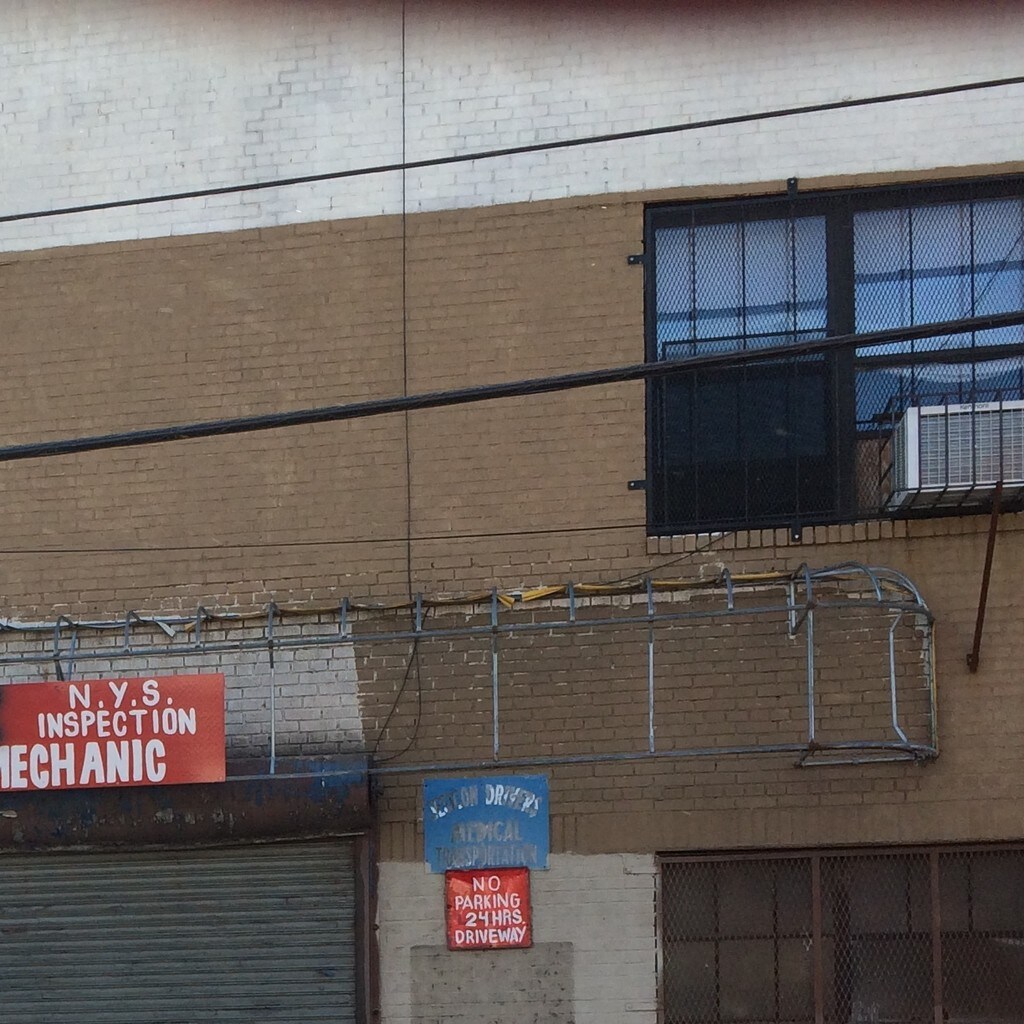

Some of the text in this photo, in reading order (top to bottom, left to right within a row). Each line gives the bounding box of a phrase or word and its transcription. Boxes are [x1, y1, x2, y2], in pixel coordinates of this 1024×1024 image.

[69, 679, 174, 709] N.Y.S.
[37, 707, 197, 738] INSPECTION
[472, 875, 500, 892] NO
[454, 893, 521, 911] PARKING
[465, 911, 489, 927] 24
[455, 926, 526, 944] DRIVEWAY
